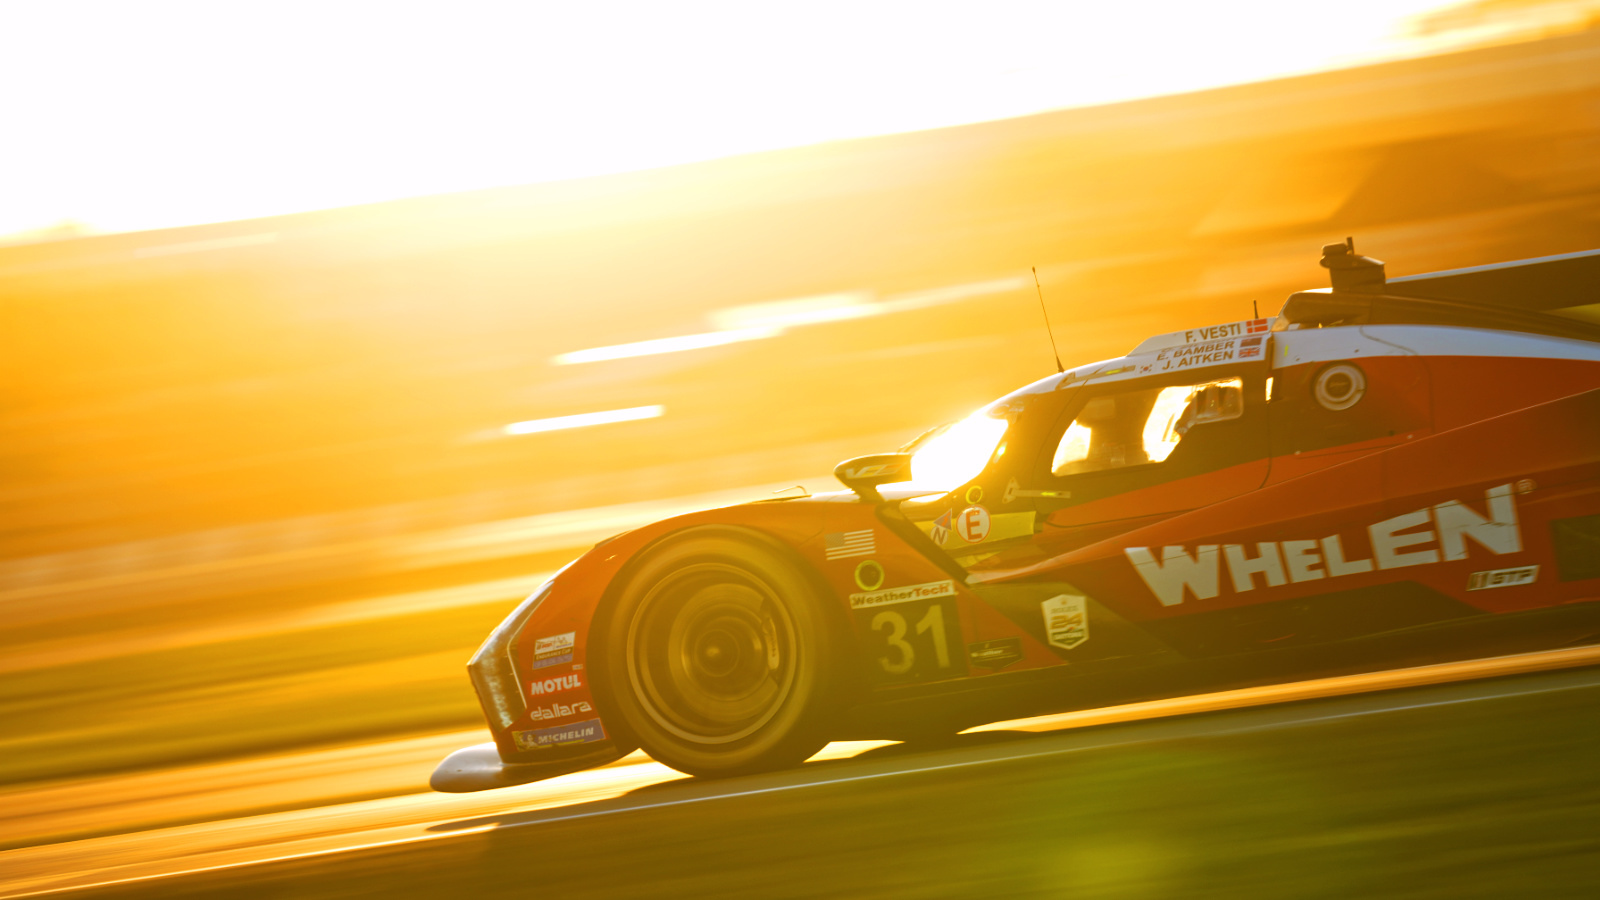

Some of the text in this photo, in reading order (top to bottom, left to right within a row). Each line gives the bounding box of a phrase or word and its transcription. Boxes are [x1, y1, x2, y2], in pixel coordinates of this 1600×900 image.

[1185, 322, 1241, 343] F. VESTI
[1156, 340, 1235, 361] E. BAMBER
[1162, 350, 1234, 370] J. AITKEN
[932, 528, 947, 544] N
[965, 510, 982, 541] E
[1124, 483, 1524, 607] WHELEN
[851, 583, 950, 607] WeatherTech
[870, 604, 951, 675] 31
[531, 674, 582, 695] MOTUL
[530, 701, 592, 721] dallara
[538, 727, 594, 744] MICHELIN
